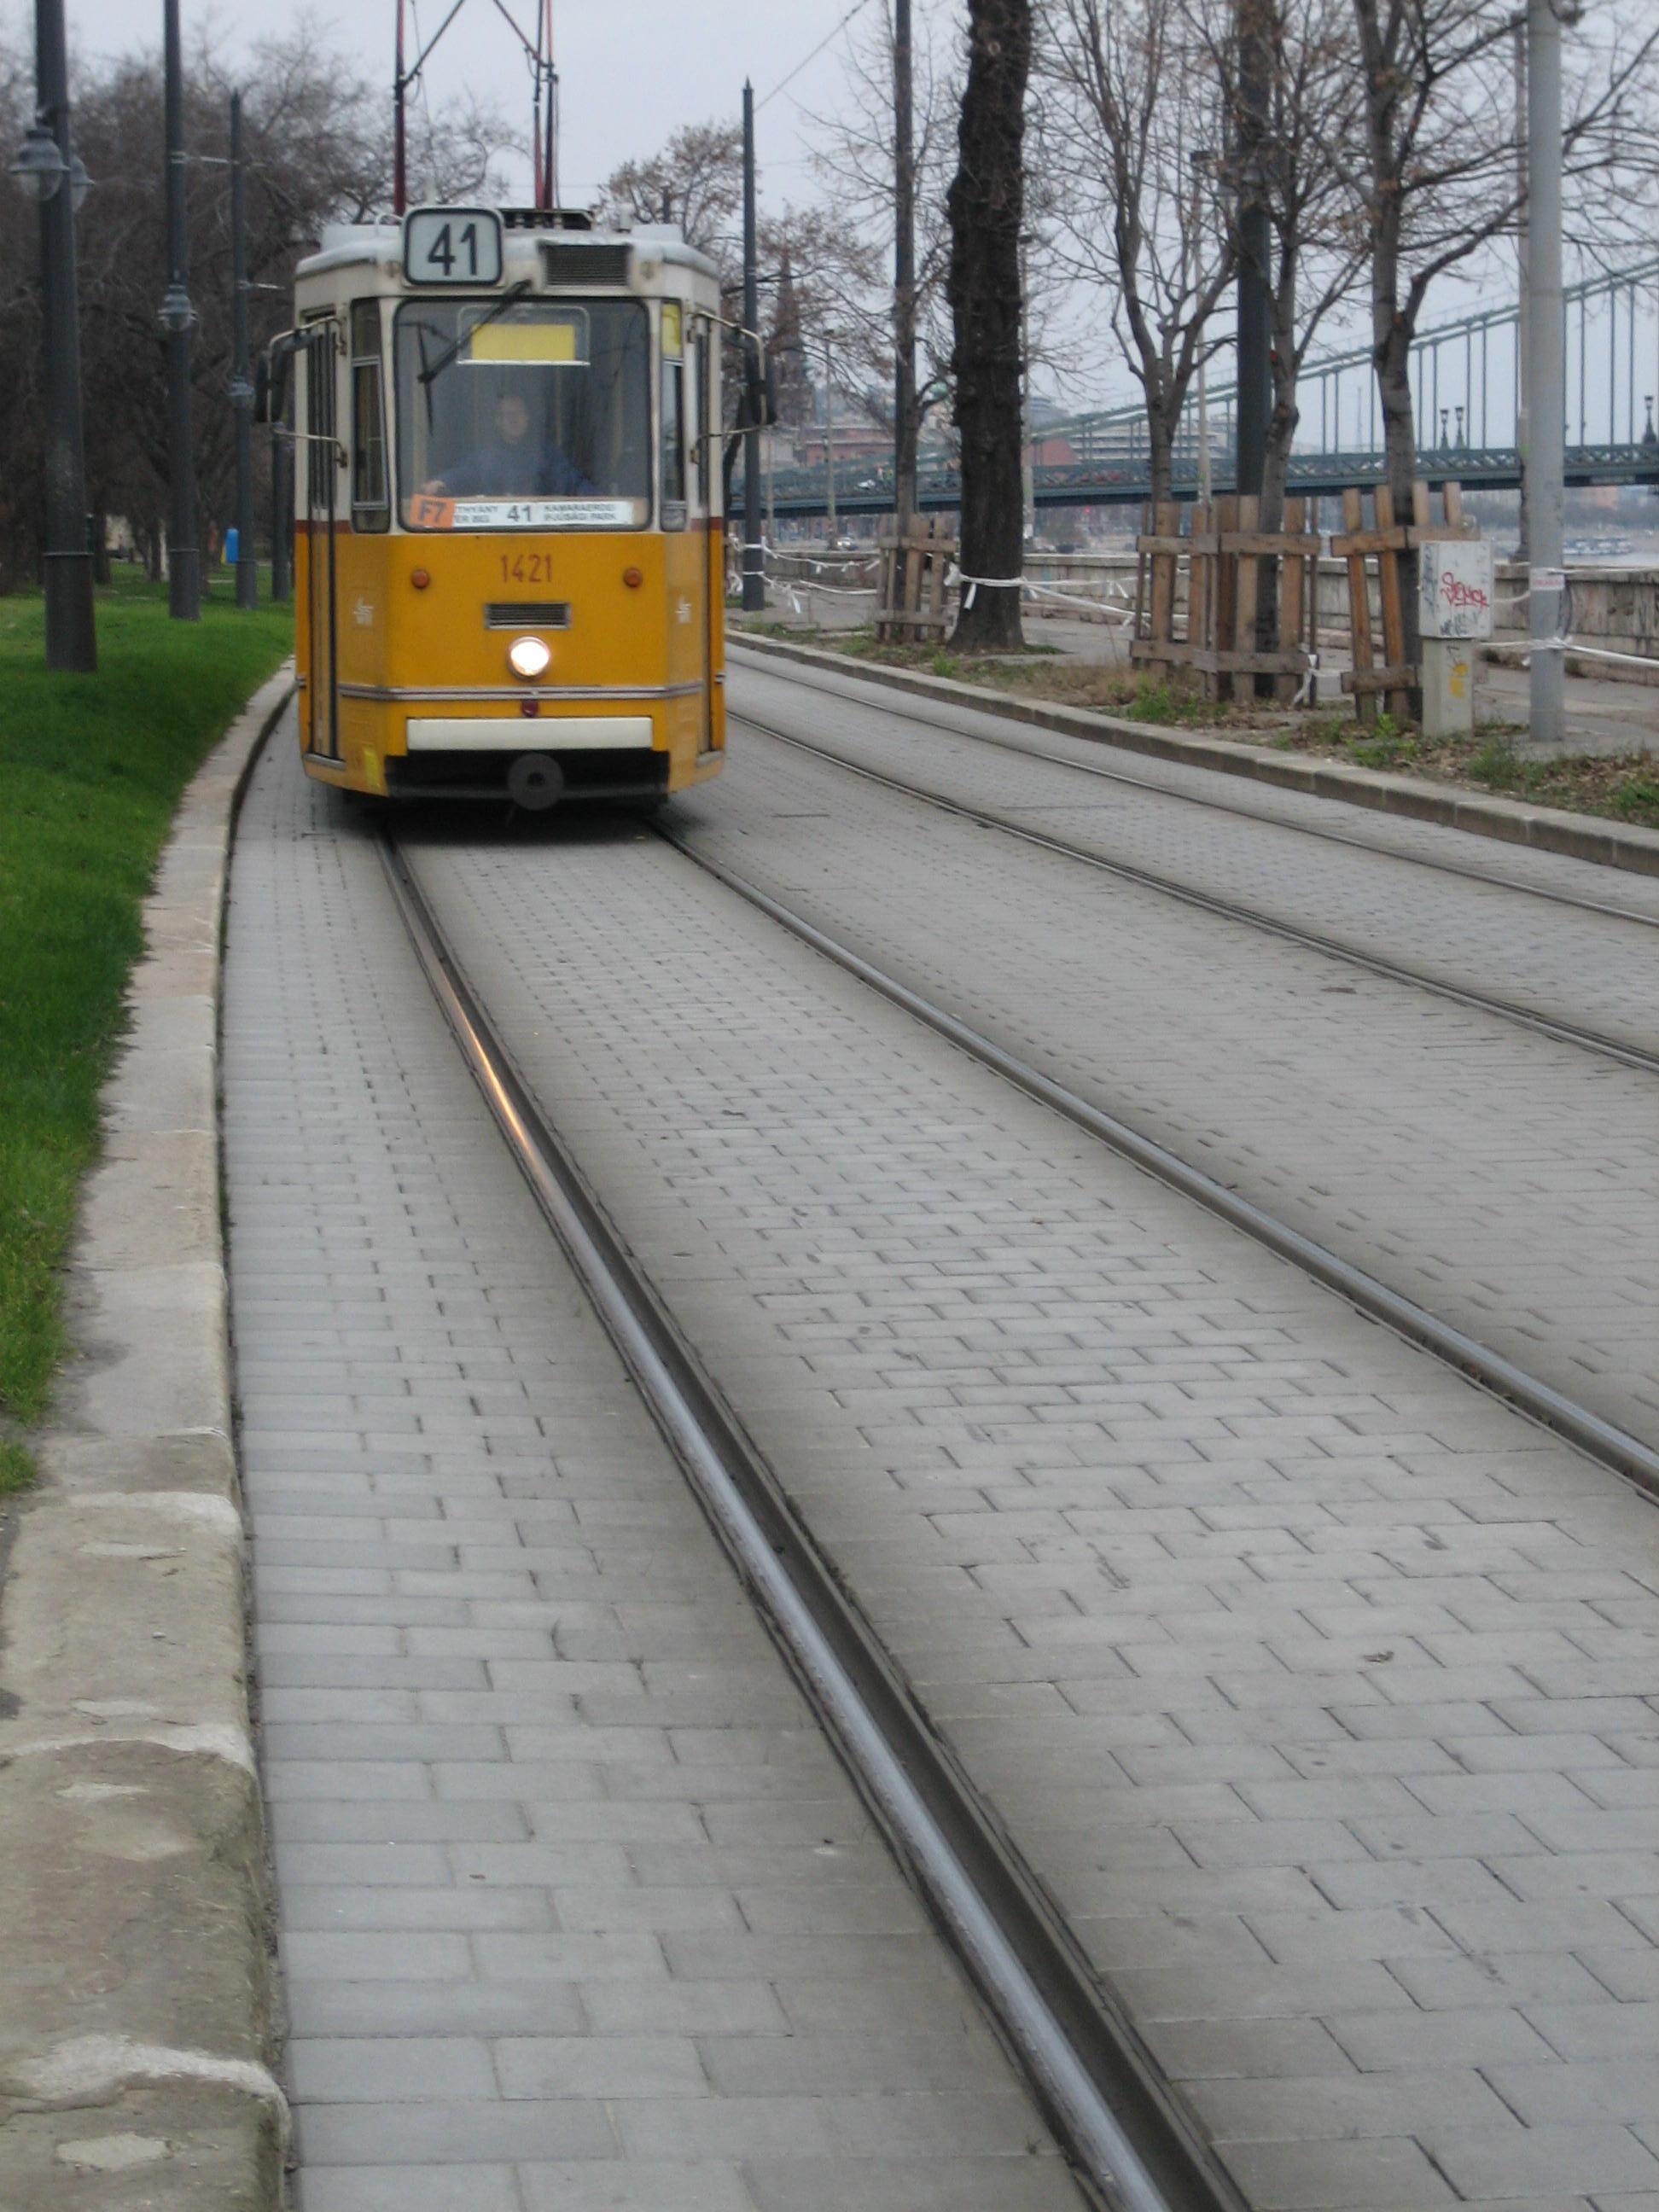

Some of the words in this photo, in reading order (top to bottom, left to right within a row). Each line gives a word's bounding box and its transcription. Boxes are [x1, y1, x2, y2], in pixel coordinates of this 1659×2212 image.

[428, 223, 476, 276] 41
[418, 499, 446, 523] F7
[507, 504, 531, 522] 41
[501, 554, 551, 583] 1421
